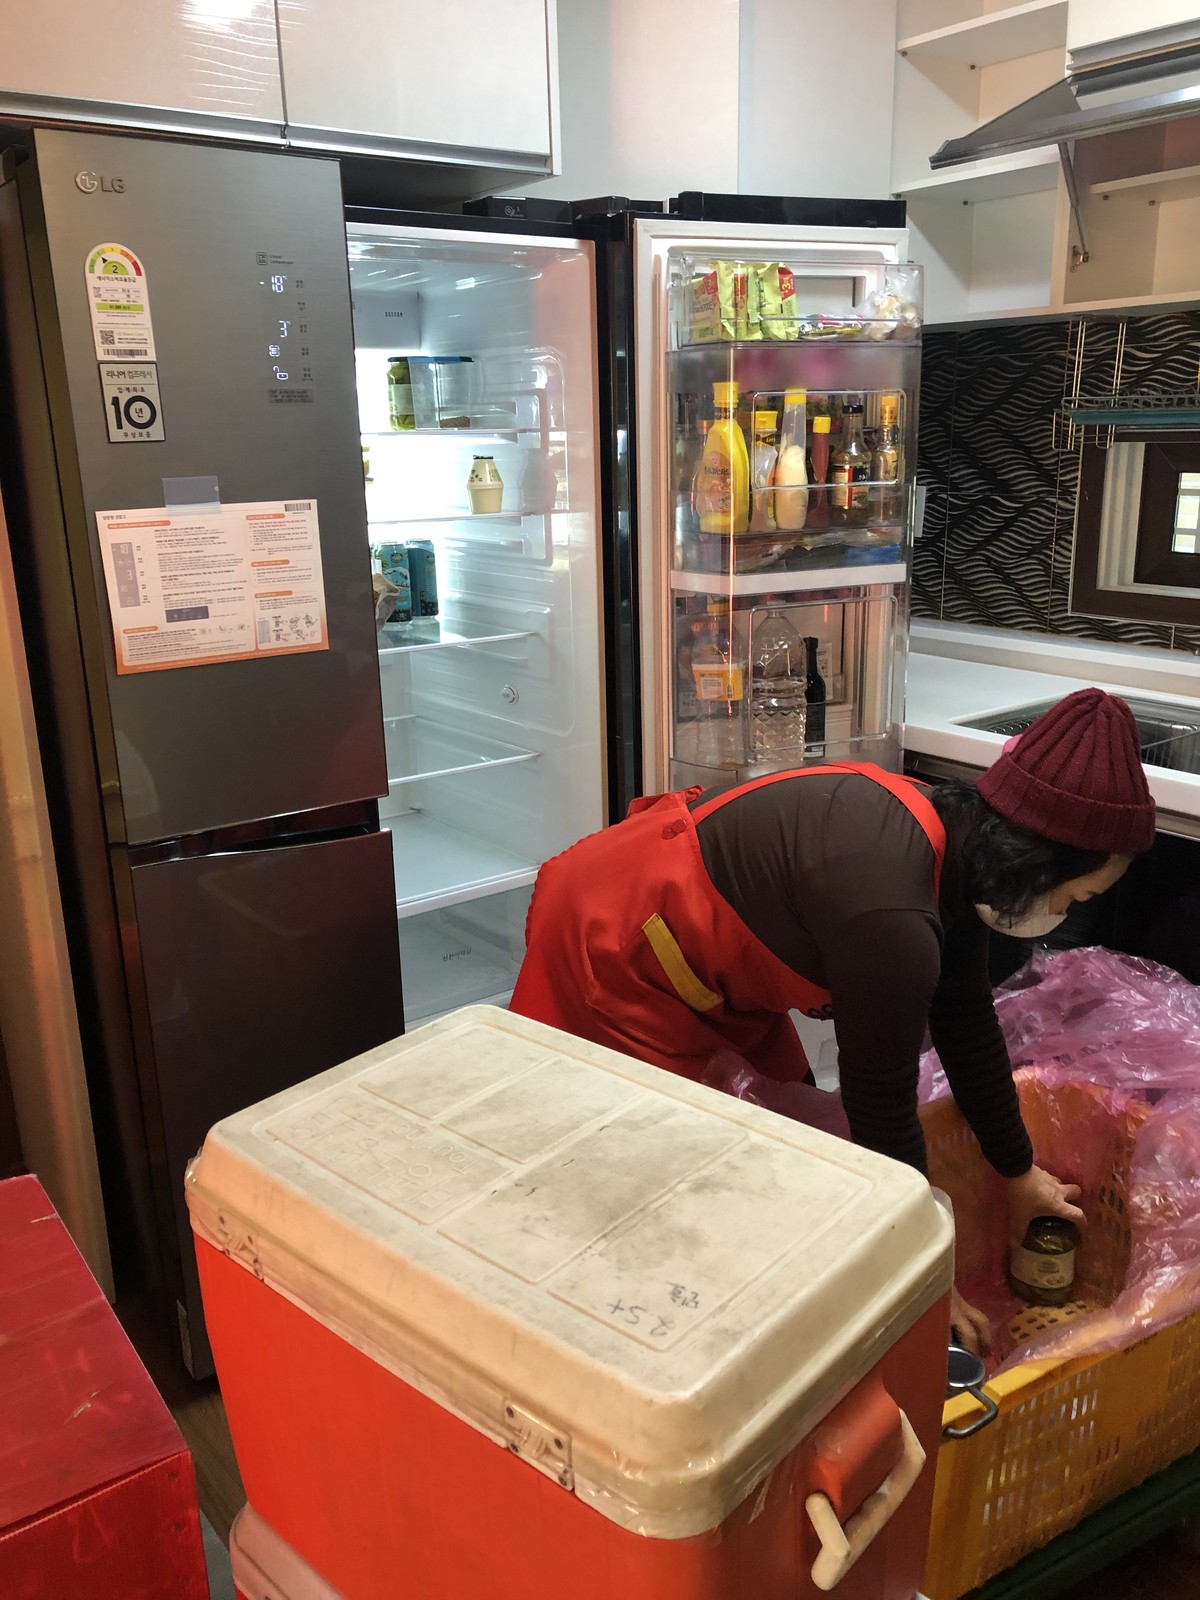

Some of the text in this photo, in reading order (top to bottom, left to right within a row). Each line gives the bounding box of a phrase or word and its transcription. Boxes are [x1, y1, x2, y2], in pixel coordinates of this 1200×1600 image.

[112, 264, 118, 274] 2
[106, 370, 126, 379] 리니어
[111, 395, 157, 430] 10
[135, 407, 144, 418] 년
[392, 1121, 480, 1175] Touring
